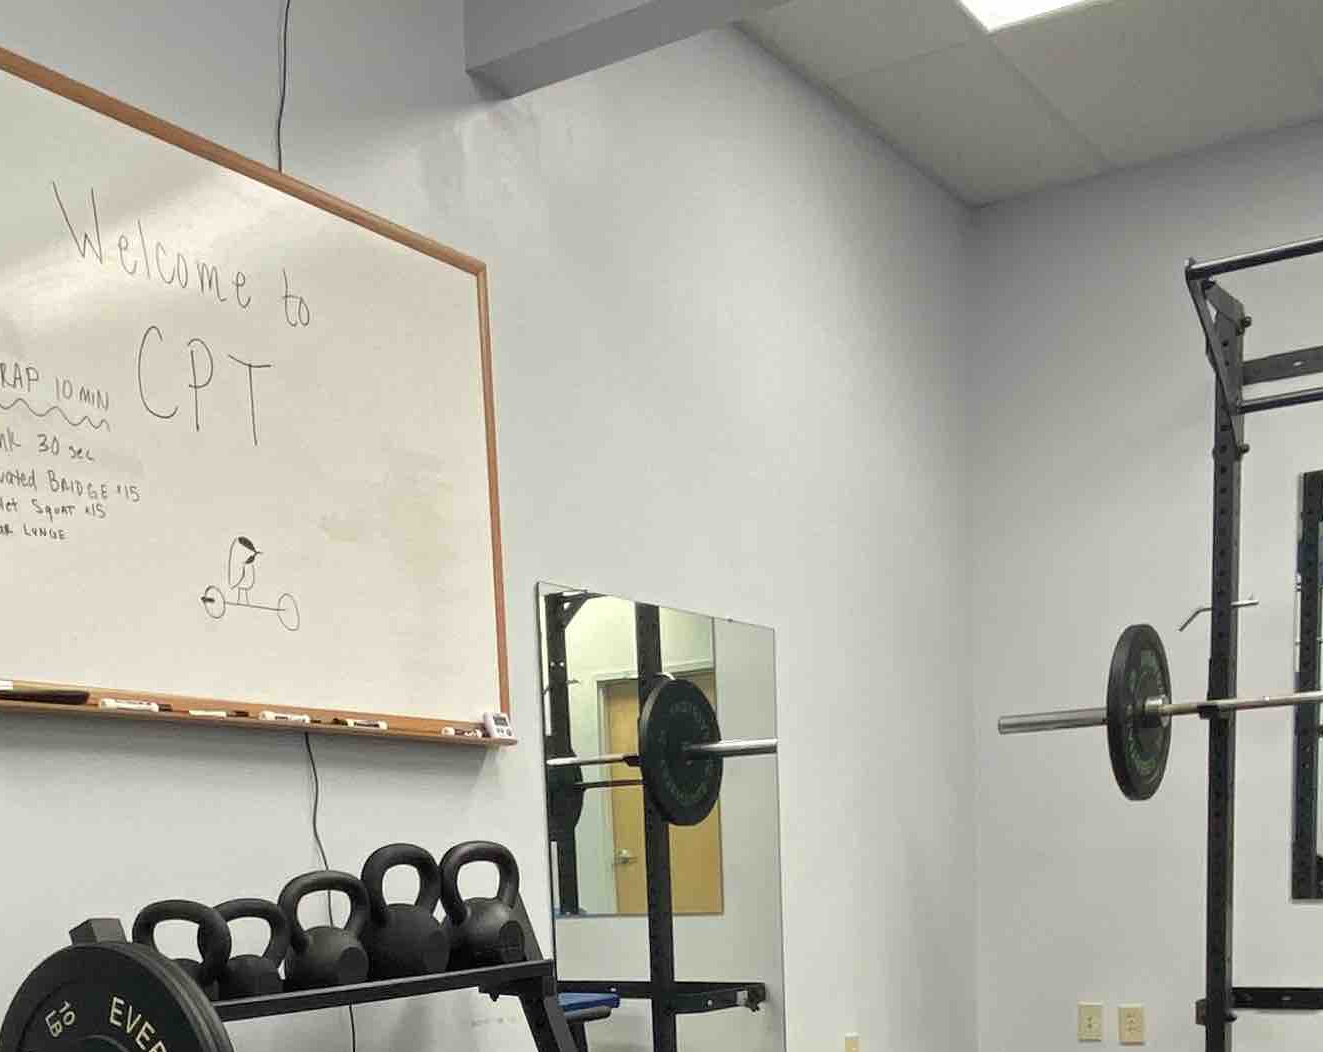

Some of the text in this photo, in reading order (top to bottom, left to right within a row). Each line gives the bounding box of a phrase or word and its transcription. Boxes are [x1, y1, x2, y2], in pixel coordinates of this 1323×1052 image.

[52, 180, 311, 328] Welcome to
[55, 376, 74, 401] 10
[137, 325, 272, 446] CPT
[37, 433, 60, 456] 30
[68, 446, 95, 462] sec
[45, 1009, 63, 1038] LB
